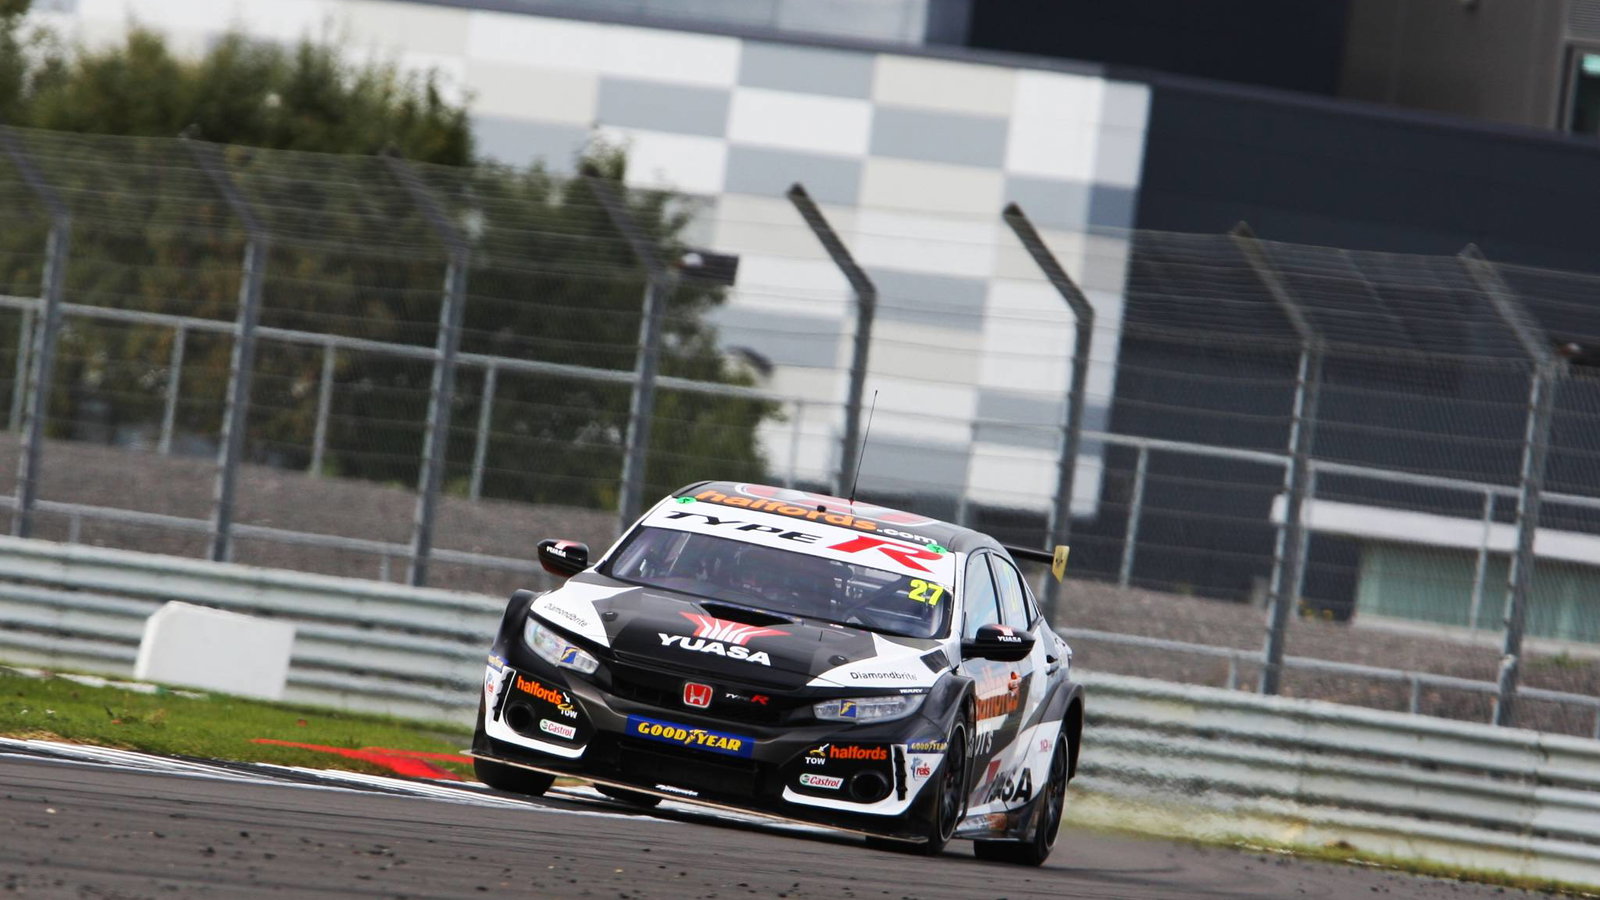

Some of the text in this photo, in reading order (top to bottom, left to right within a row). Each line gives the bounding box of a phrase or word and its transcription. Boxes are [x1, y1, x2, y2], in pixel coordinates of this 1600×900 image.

[695, 489, 938, 546] halfords.com
[665, 510, 945, 574] TYPE R
[908, 578, 944, 606] 27
[657, 632, 772, 667] YUASA
[516, 675, 564, 705] halfords
[560, 708, 578, 719] TOW
[547, 722, 574, 737] Castrol
[637, 721, 742, 752] GOODYEAR
[804, 756, 826, 766] TOW
[829, 744, 888, 761] halfords
[809, 775, 841, 788] Castrol
